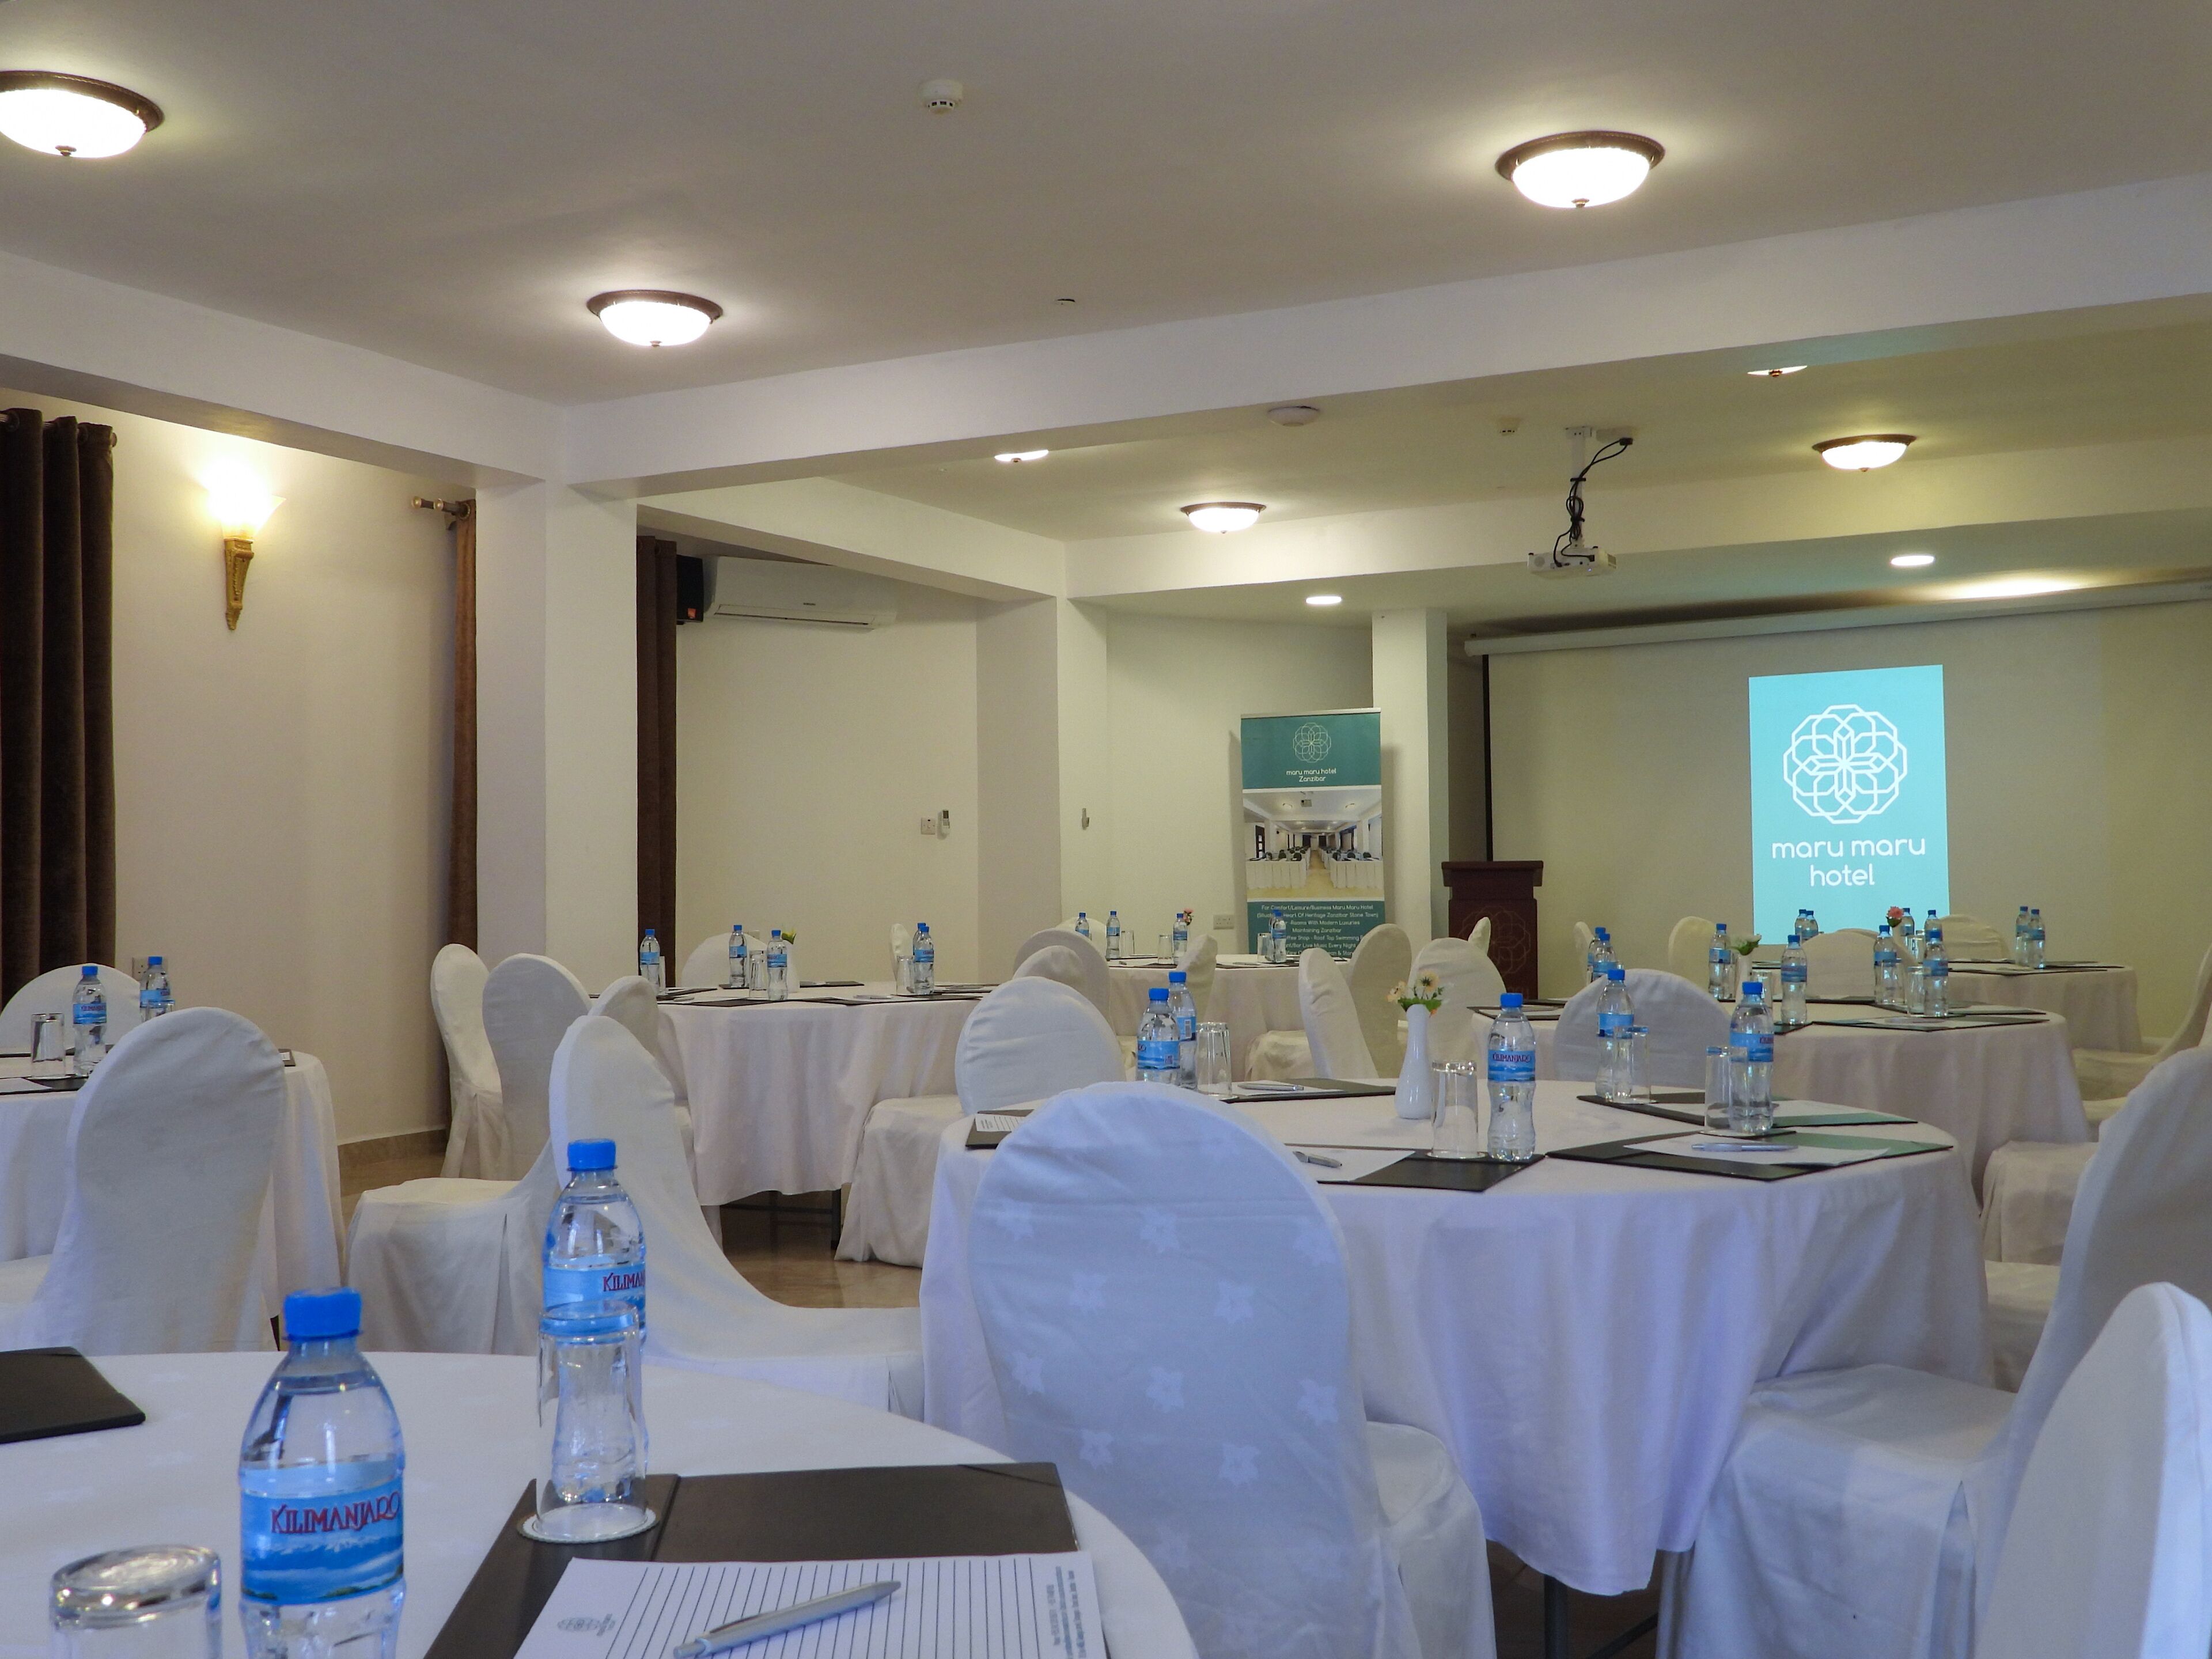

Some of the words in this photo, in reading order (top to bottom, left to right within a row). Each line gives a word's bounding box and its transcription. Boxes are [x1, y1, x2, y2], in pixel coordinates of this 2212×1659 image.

[1772, 840, 1843, 858] maru
[1851, 837, 1926, 857] maru
[1810, 863, 1874, 887] hotel
[1492, 1052, 1532, 1063] KILIMANJARO
[271, 1490, 402, 1535] KILIMANJARO
